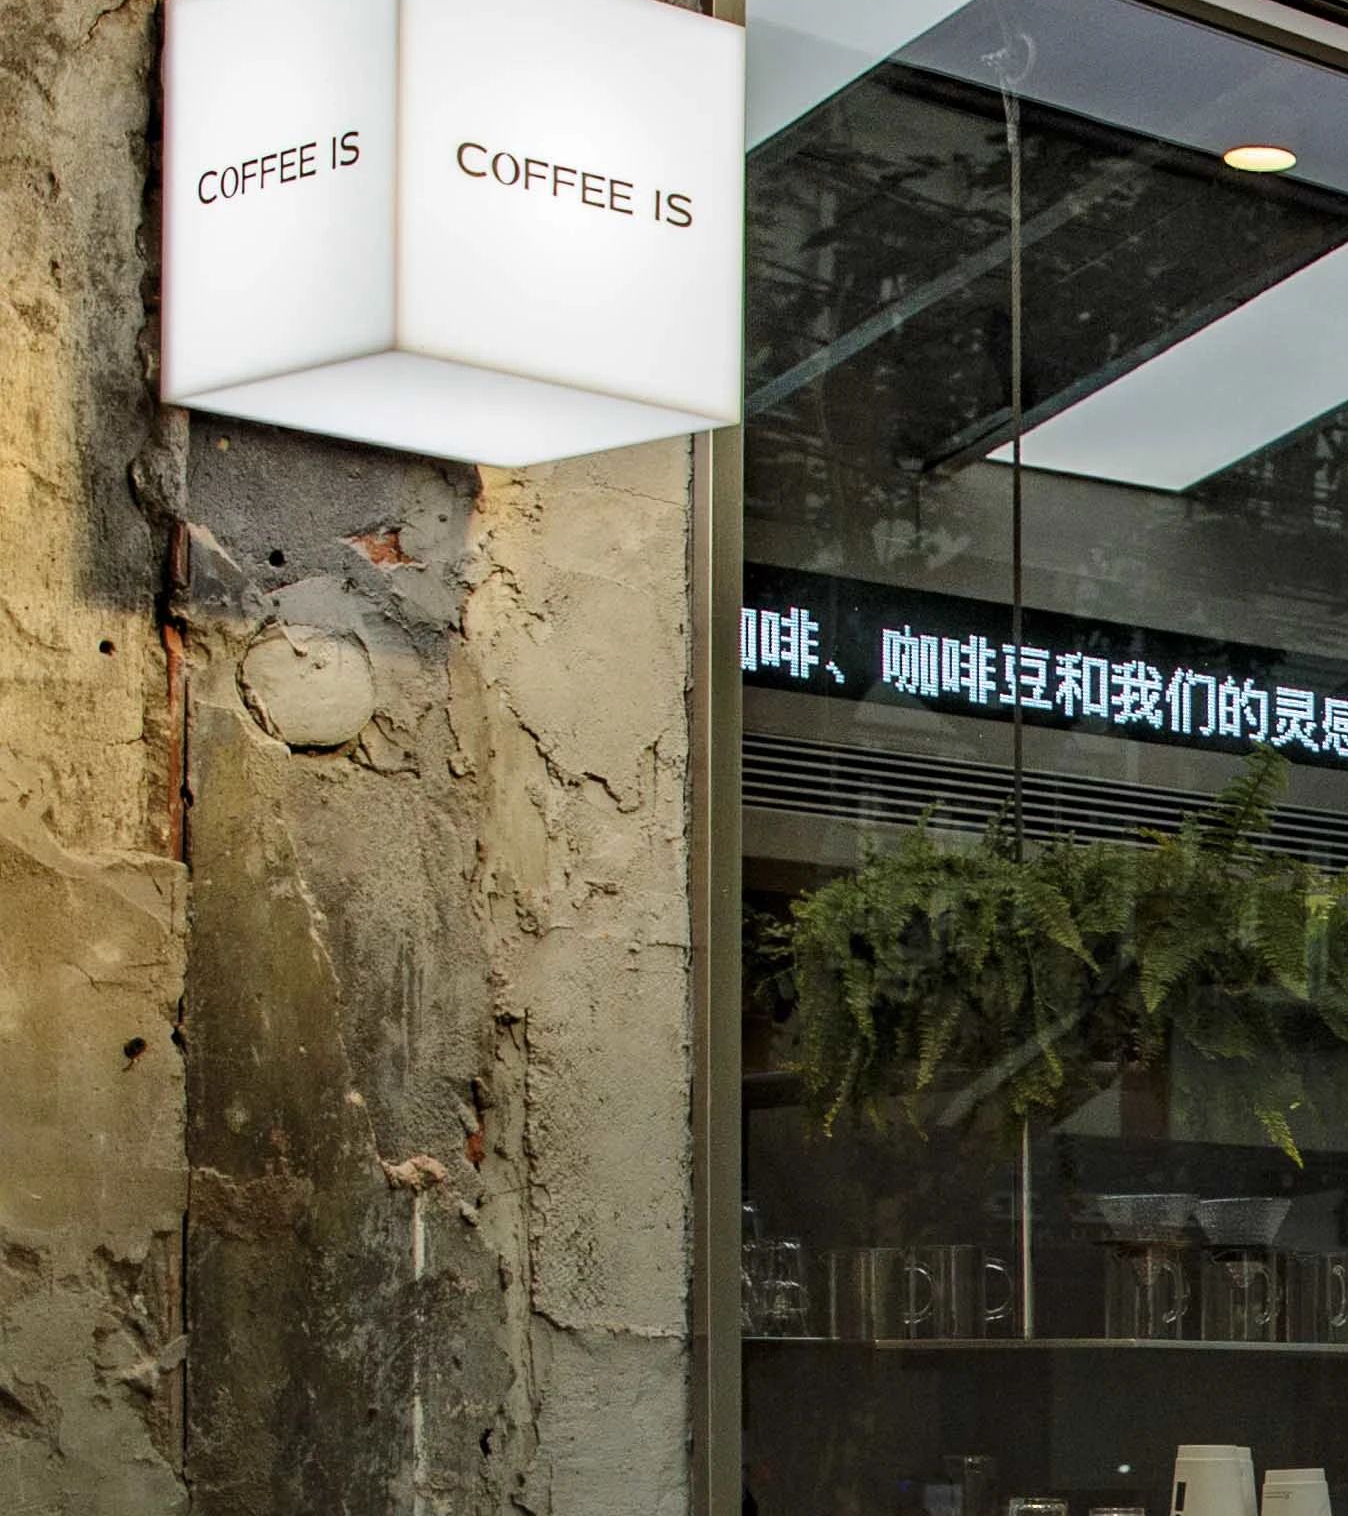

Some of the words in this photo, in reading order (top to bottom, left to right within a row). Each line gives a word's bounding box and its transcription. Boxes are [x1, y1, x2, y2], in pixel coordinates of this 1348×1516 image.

[197, 141, 318, 205] COFFEE
[330, 130, 361, 170] IS
[455, 141, 634, 216] COFFEE
[653, 190, 693, 228] IS
